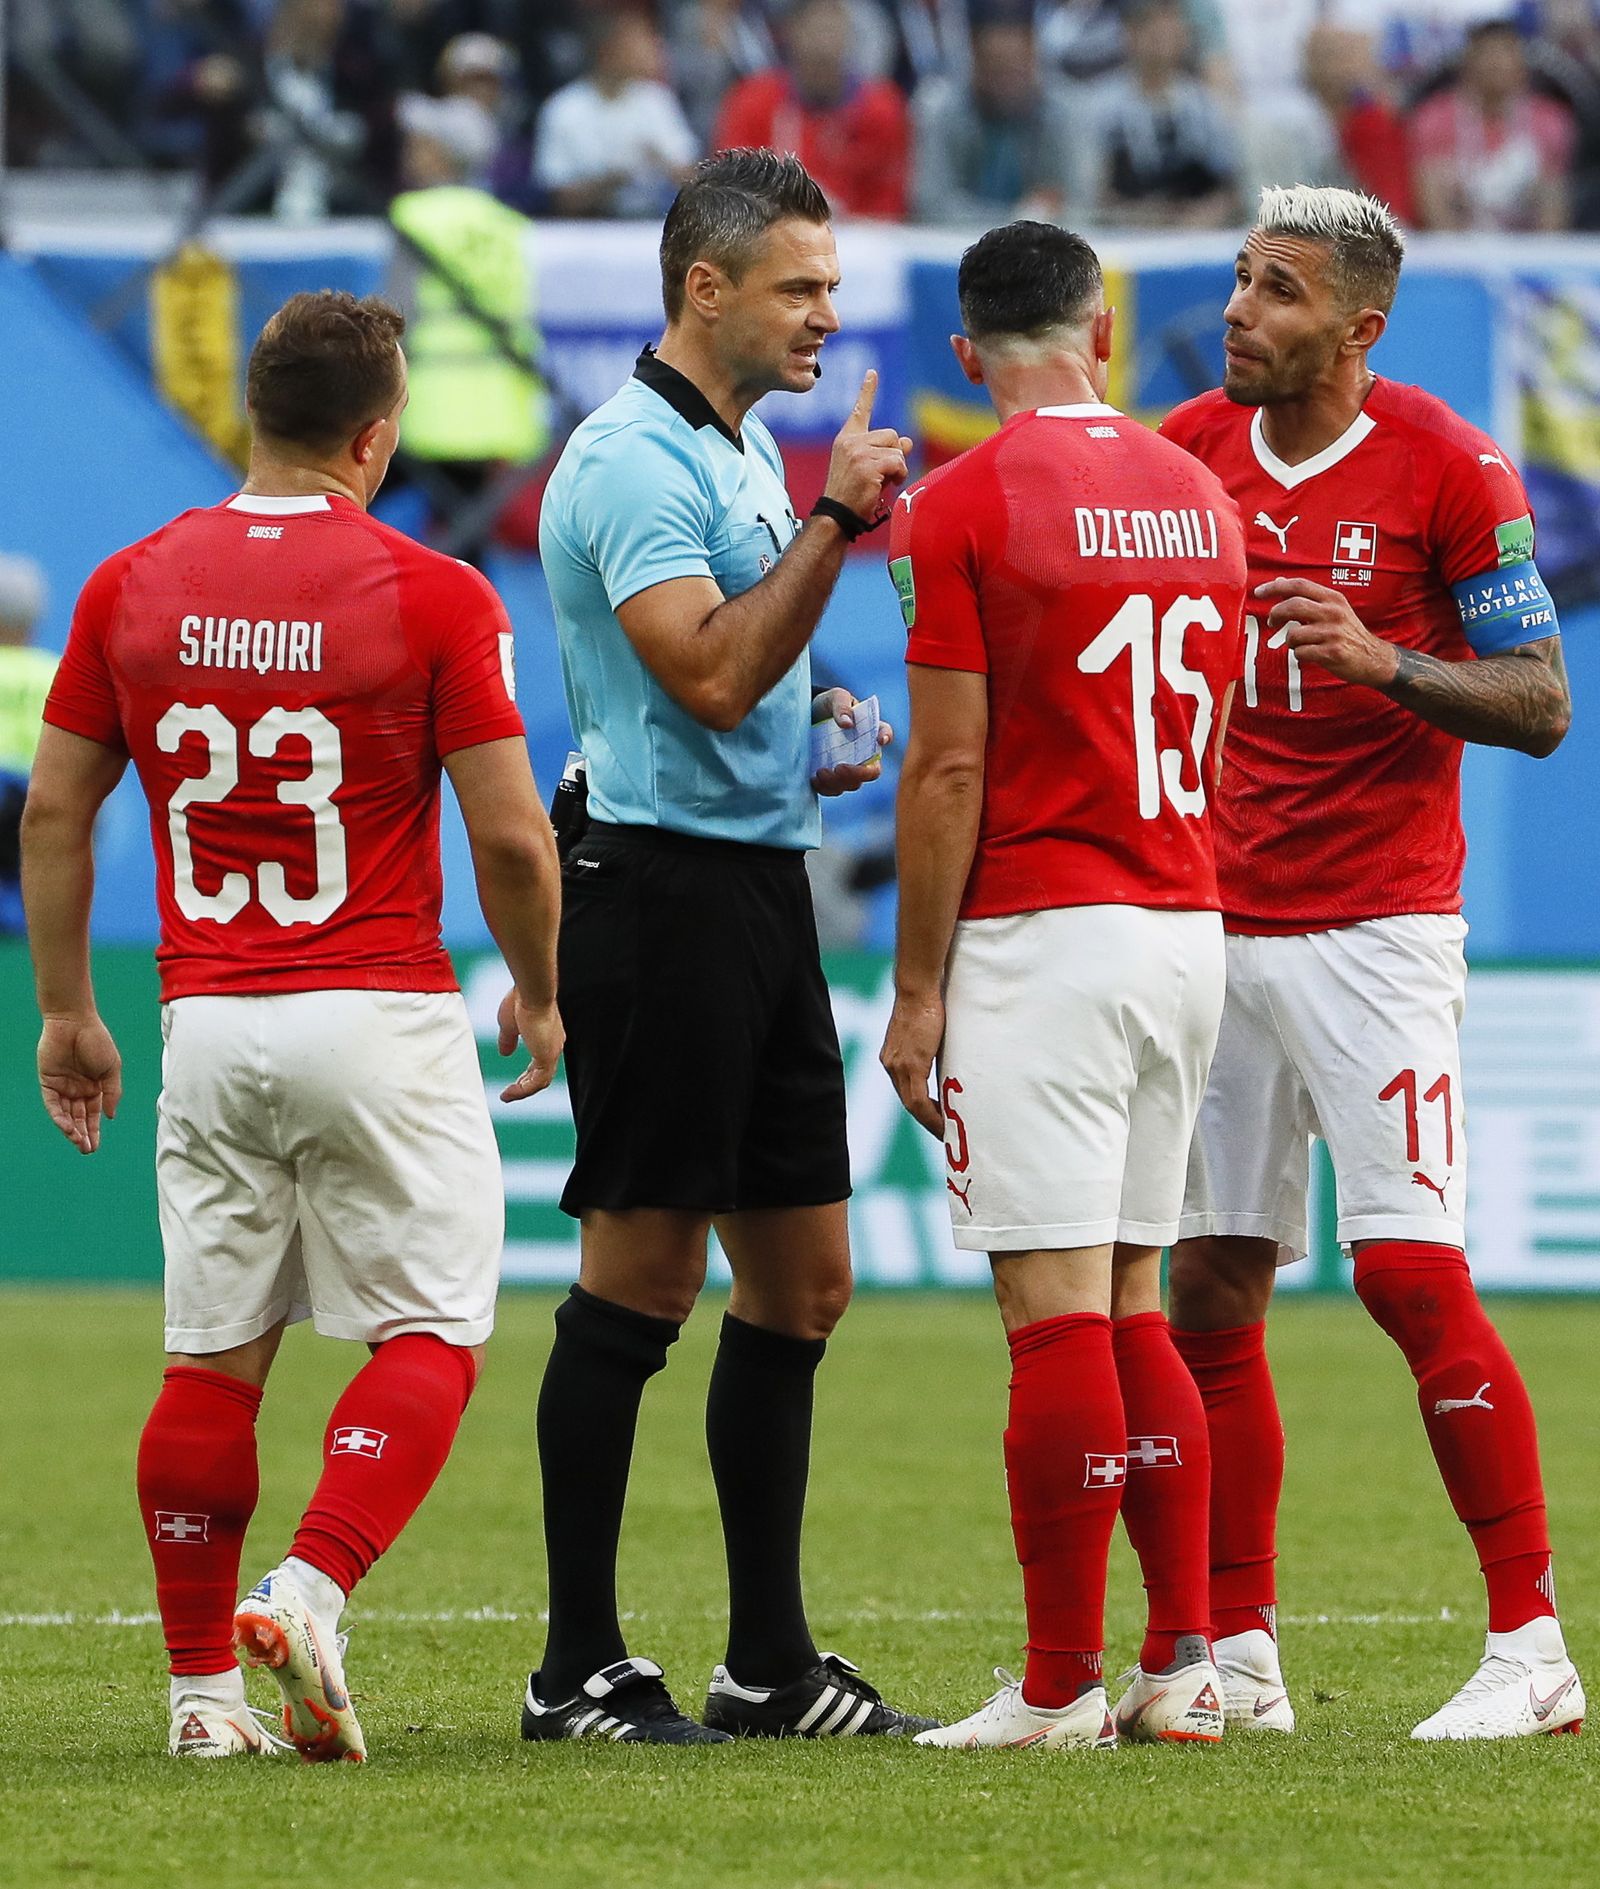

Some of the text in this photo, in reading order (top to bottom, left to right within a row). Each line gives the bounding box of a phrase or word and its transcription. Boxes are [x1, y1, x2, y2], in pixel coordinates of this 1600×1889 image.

[1085, 426, 1120, 439] SUISSE
[246, 525, 284, 539] SUISSE
[1073, 507, 1218, 559] DZEMAILI
[1331, 568, 1350, 580] SWE
[1358, 569, 1372, 581] SUI
[1458, 575, 1539, 609] LIVING
[1521, 609, 1552, 628] FIFA
[178, 614, 323, 675] SHAQIRI
[1244, 614, 1303, 712] 11
[1077, 594, 1224, 820] 15
[155, 701, 348, 927] 23
[1378, 1069, 1453, 1167] 11
[609, 1668, 638, 1684] adidas
